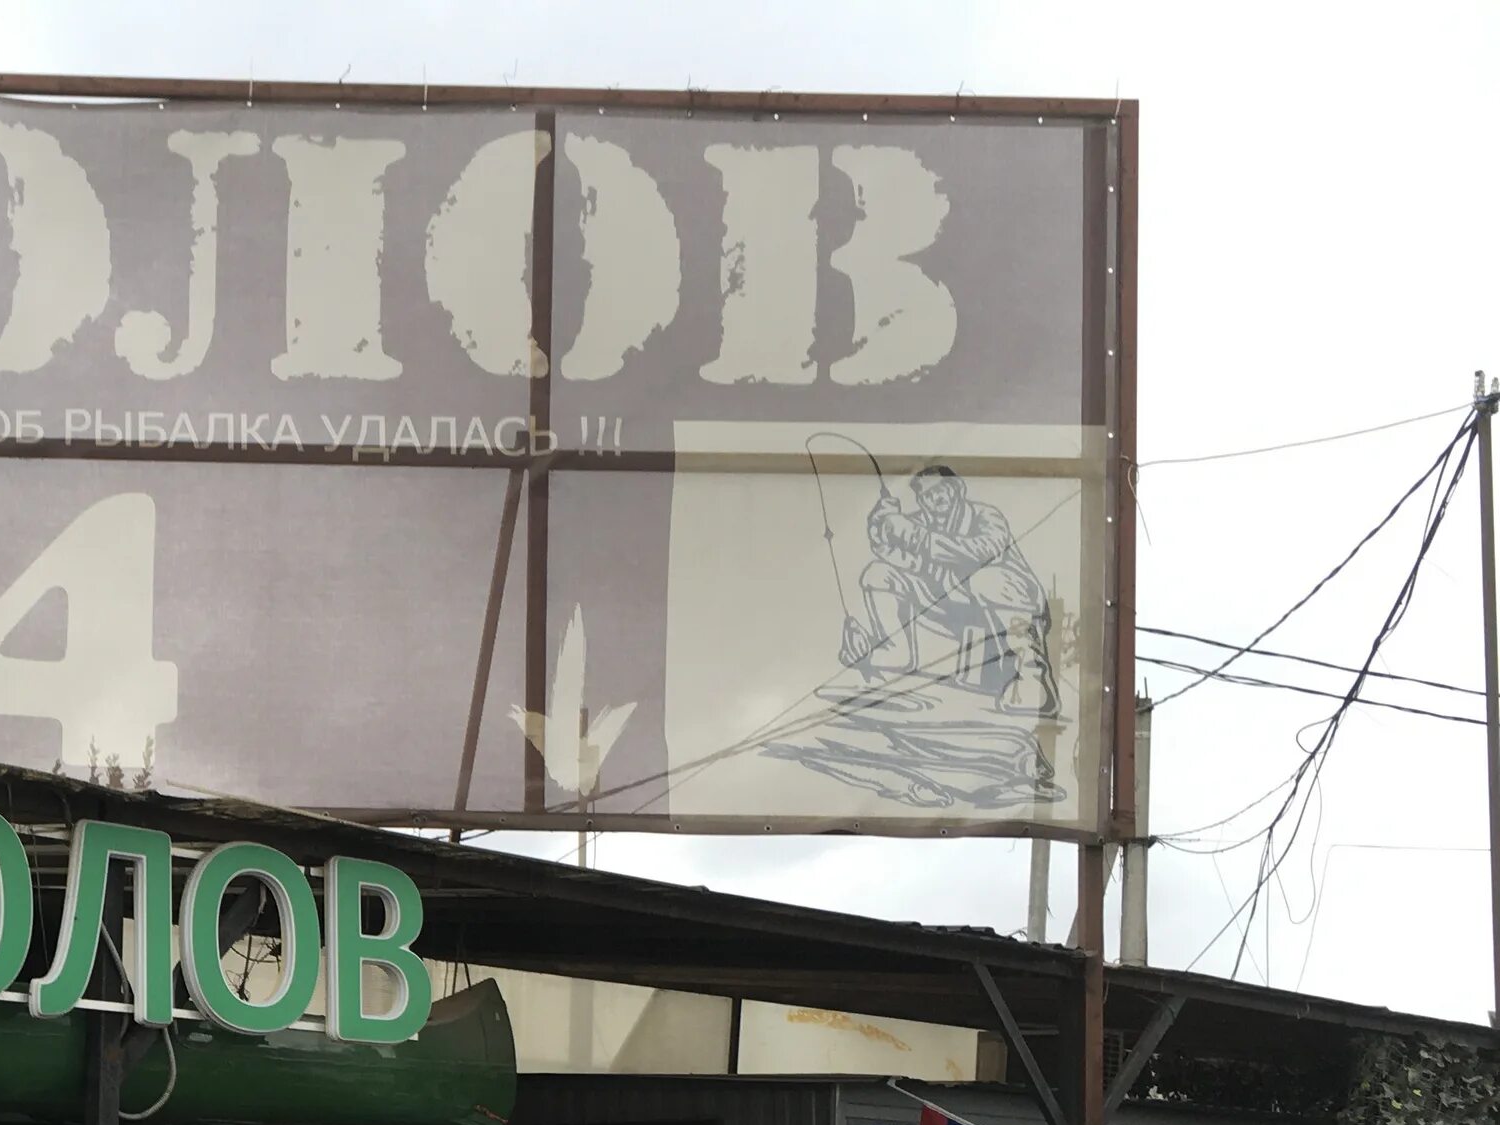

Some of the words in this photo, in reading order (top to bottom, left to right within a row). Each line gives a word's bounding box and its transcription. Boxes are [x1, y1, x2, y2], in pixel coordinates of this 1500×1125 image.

[63, 408, 303, 452] РЫБАЛКА
[320, 413, 560, 463] УДАЛАСЬ
[580, 415, 623, 456] !!!
